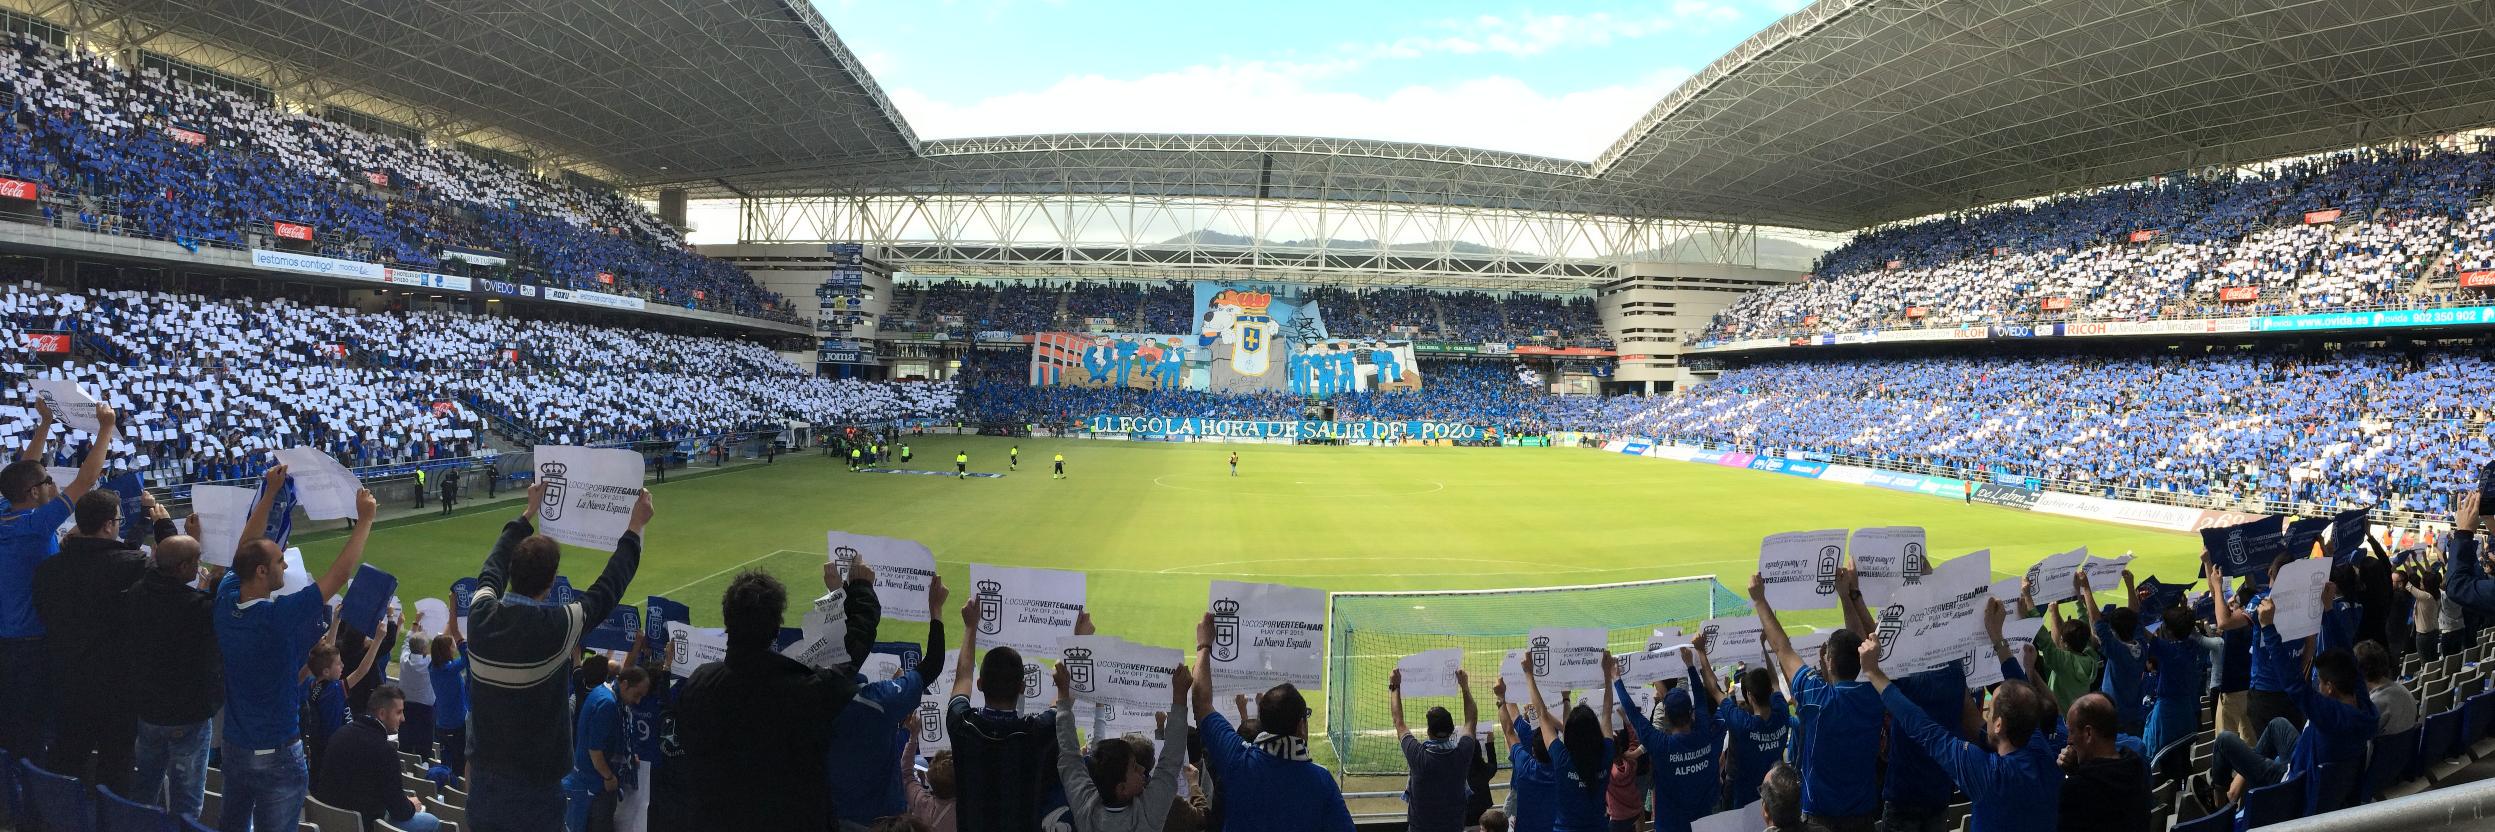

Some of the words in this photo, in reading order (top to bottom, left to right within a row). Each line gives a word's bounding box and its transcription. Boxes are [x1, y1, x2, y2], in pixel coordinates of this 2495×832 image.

[278, 224, 305, 239] Coca-Cola
[484, 280, 514, 294] OVIEDO
[2226, 288, 2254, 301] Coca-Cola
[2297, 316, 2369, 327] www.ovida.es
[2413, 314, 2432, 323] 902
[2434, 313, 2454, 322] 350
[2456, 311, 2476, 321] 902
[1954, 328, 1985, 338] RICOH
[1998, 326, 2028, 336] OVIEDO
[2067, 323, 2106, 335] RICOH
[1165, 418, 1196, 435] LA
[1200, 419, 1261, 436] HORA
[1266, 420, 1299, 438] DE
[1303, 420, 1366, 439] SALIR
[1422, 422, 1475, 438] POZO
[568, 480, 641, 497] LOCOSPORVERTEGANA
[576, 498, 586, 509] La
[587, 499, 606, 511] Nueva
[606, 501, 631, 515] España
[2077, 501, 2100, 513] Auto
[874, 578, 883, 587] La
[885, 579, 903, 590] Nueva
[1018, 613, 1027, 623] La
[1028, 613, 1047, 625] Nueva
[1048, 615, 1072, 627] España
[1253, 636, 1264, 647] La
[1264, 636, 1284, 648] Nueva
[1286, 637, 1312, 650] España
[1096, 661, 1176, 675] OCOSPORVERTEGANA
[1567, 658, 1581, 667] Nueva
[1108, 675, 1117, 684] La
[1119, 676, 1140, 687] Nueva
[1142, 679, 1168, 690] España
[637, 719, 650, 741] 9
[1266, 735, 1308, 761] VIE
[1674, 760, 1709, 776] ALFONSO
